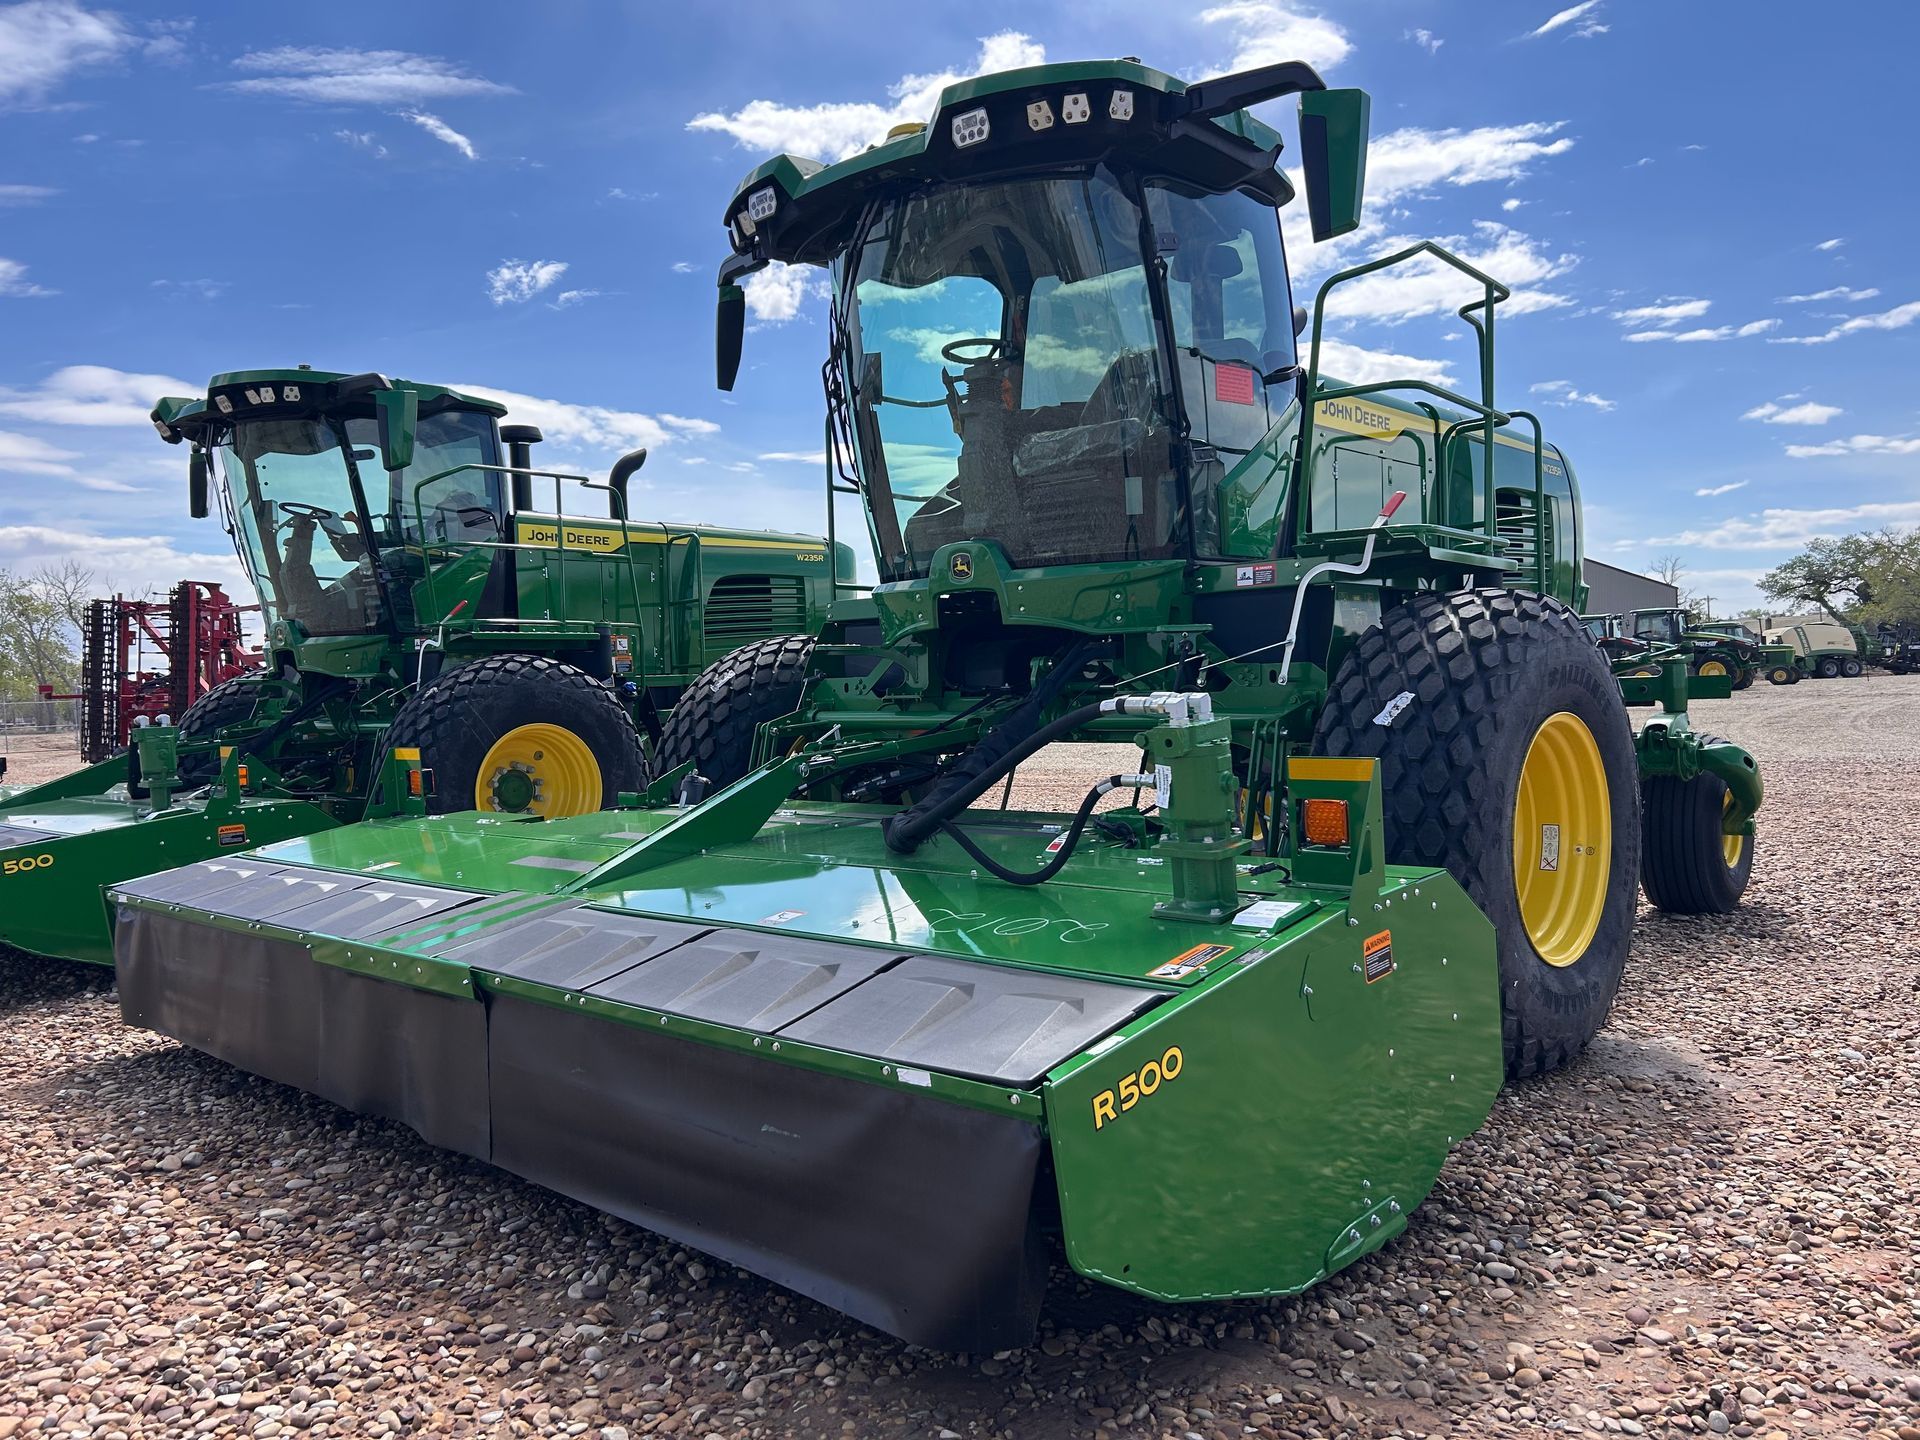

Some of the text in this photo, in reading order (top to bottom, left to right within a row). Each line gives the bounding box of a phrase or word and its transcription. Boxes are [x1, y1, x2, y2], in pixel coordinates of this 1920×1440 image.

[1321, 400, 1391, 431] JOHN DEERE
[567, 532, 610, 546] DEERE
[796, 554, 824, 562] W235R
[2, 853, 55, 875] 500
[1091, 1044, 1184, 1132] R 500
